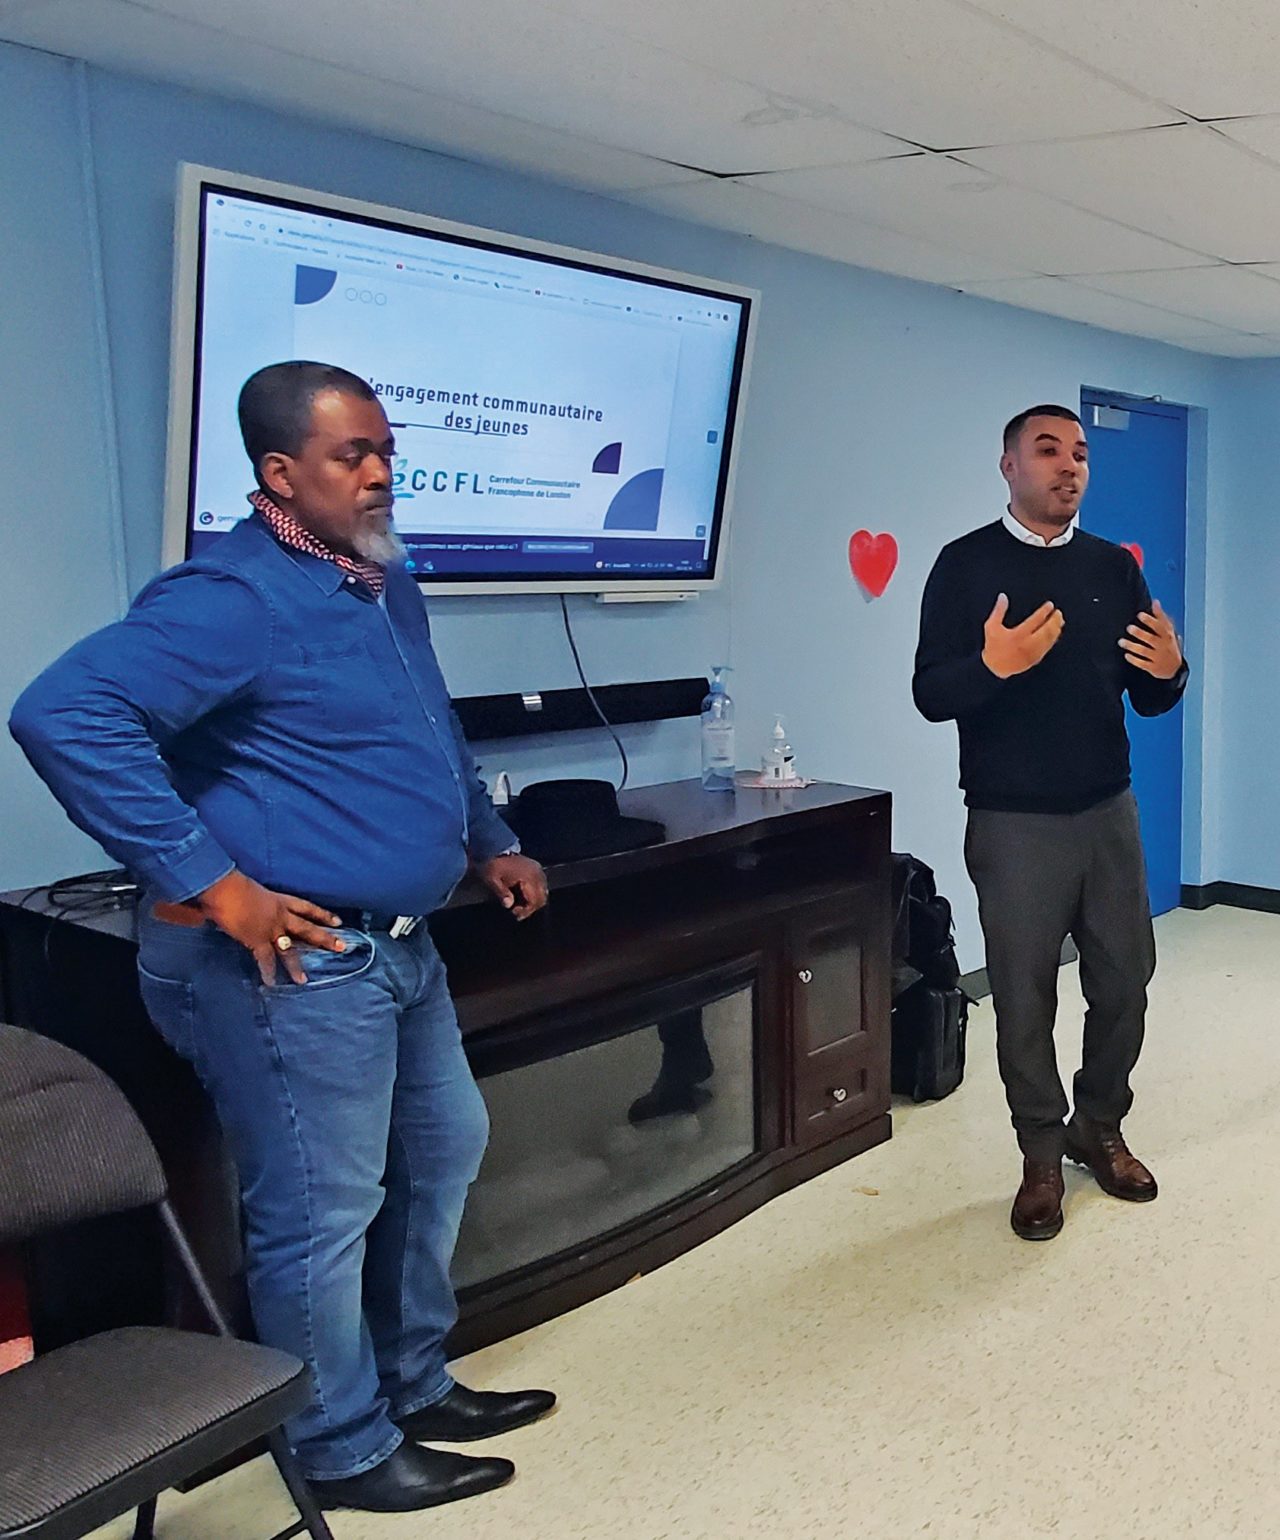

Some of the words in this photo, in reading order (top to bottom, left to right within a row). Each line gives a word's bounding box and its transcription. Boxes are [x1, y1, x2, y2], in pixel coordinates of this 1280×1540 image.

[369, 377, 479, 407] 'engagement
[483, 396, 604, 423] communautaire
[444, 410, 473, 430] des
[474, 414, 529, 436] jeunes
[411, 468, 484, 494] CCFL
[489, 475, 525, 485] Carrefour
[536, 490, 545, 498] de
